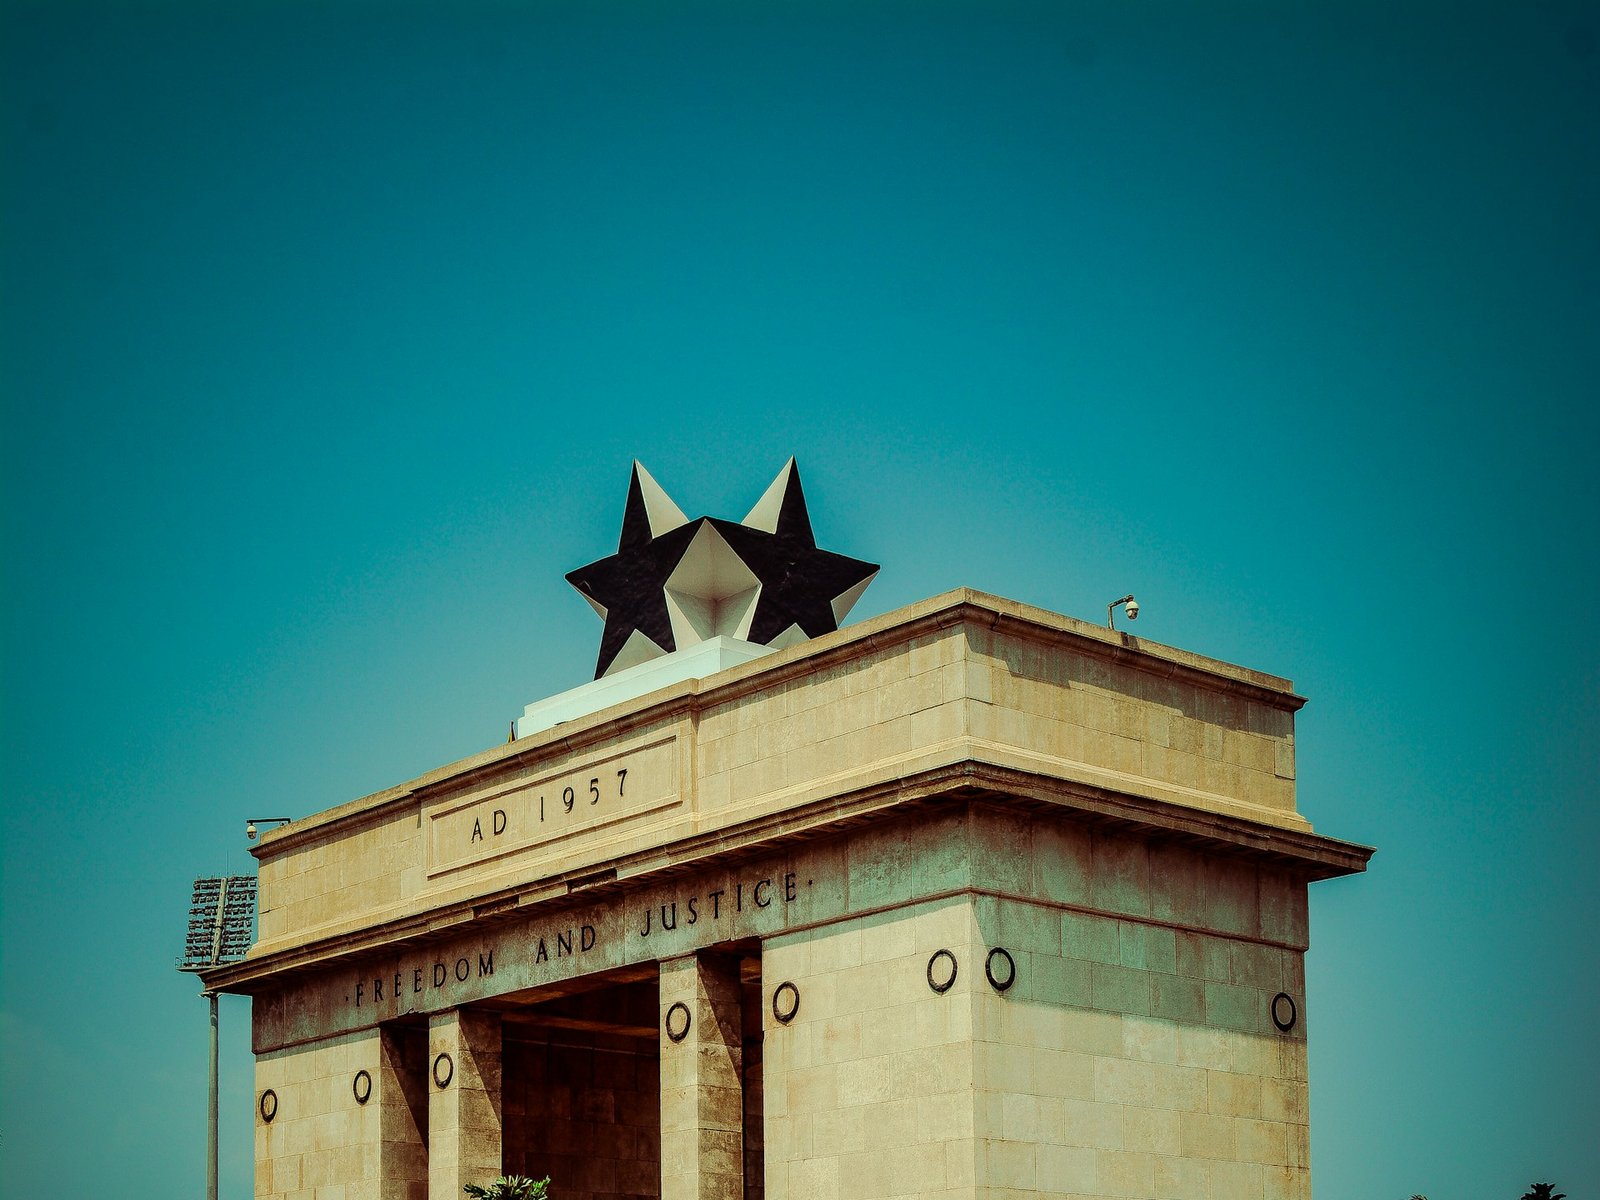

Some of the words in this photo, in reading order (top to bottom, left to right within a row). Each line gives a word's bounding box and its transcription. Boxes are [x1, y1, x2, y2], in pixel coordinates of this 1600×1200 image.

[470, 809, 507, 844] AD
[540, 768, 628, 822] 1957
[535, 925, 596, 963] AND
